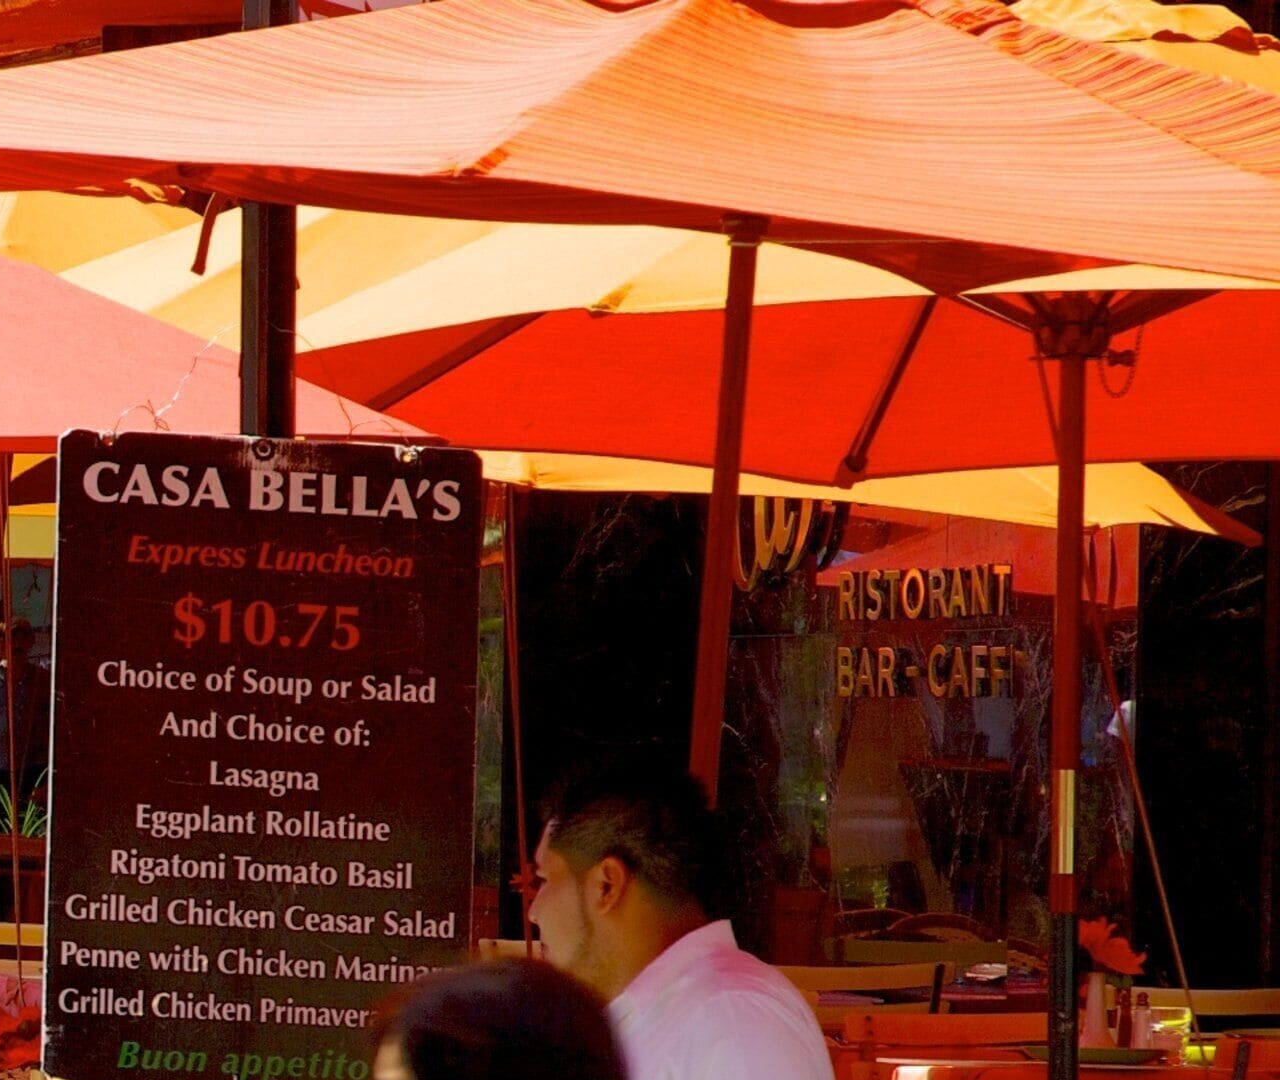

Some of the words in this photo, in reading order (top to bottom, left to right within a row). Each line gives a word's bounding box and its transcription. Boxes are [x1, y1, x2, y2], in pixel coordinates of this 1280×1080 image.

[82, 461, 230, 509] CASA
[248, 470, 462, 522] BELLA'S
[127, 535, 246, 574] Express
[257, 541, 415, 578] Luncheon
[839, 564, 1012, 621] RISTORANT
[173, 593, 361, 650] $10.75
[97, 660, 196, 690] Choice
[205, 666, 236, 694] of
[243, 669, 313, 704] Soup
[322, 678, 352, 699] or
[361, 675, 437, 704] Salad
[837, 646, 896, 698] BAR
[928, 644, 1013, 698] CAFF
[160, 711, 217, 739] And
[227, 714, 325, 745] Choice
[334, 720, 370, 747] of:
[209, 760, 320, 797] Lasagna
[136, 804, 256, 839] Eggplant
[265, 810, 391, 842] Rollatine
[111, 849, 226, 884] Rigatoni
[233, 855, 338, 886] Tomato
[348, 861, 413, 890] Basil
[65, 893, 159, 925] Grilled
[167, 899, 276, 930] Chicken
[285, 905, 375, 936] Ceasar
[384, 910, 455, 939] Salad
[60, 941, 140, 970] Penne
[149, 945, 209, 974] with
[217, 949, 326, 980] Chicken
[58, 988, 144, 1017] Grilled
[152, 992, 252, 1022] Chicken
[260, 999, 378, 1029] Primaver
[117, 1040, 208, 1072] Buon
